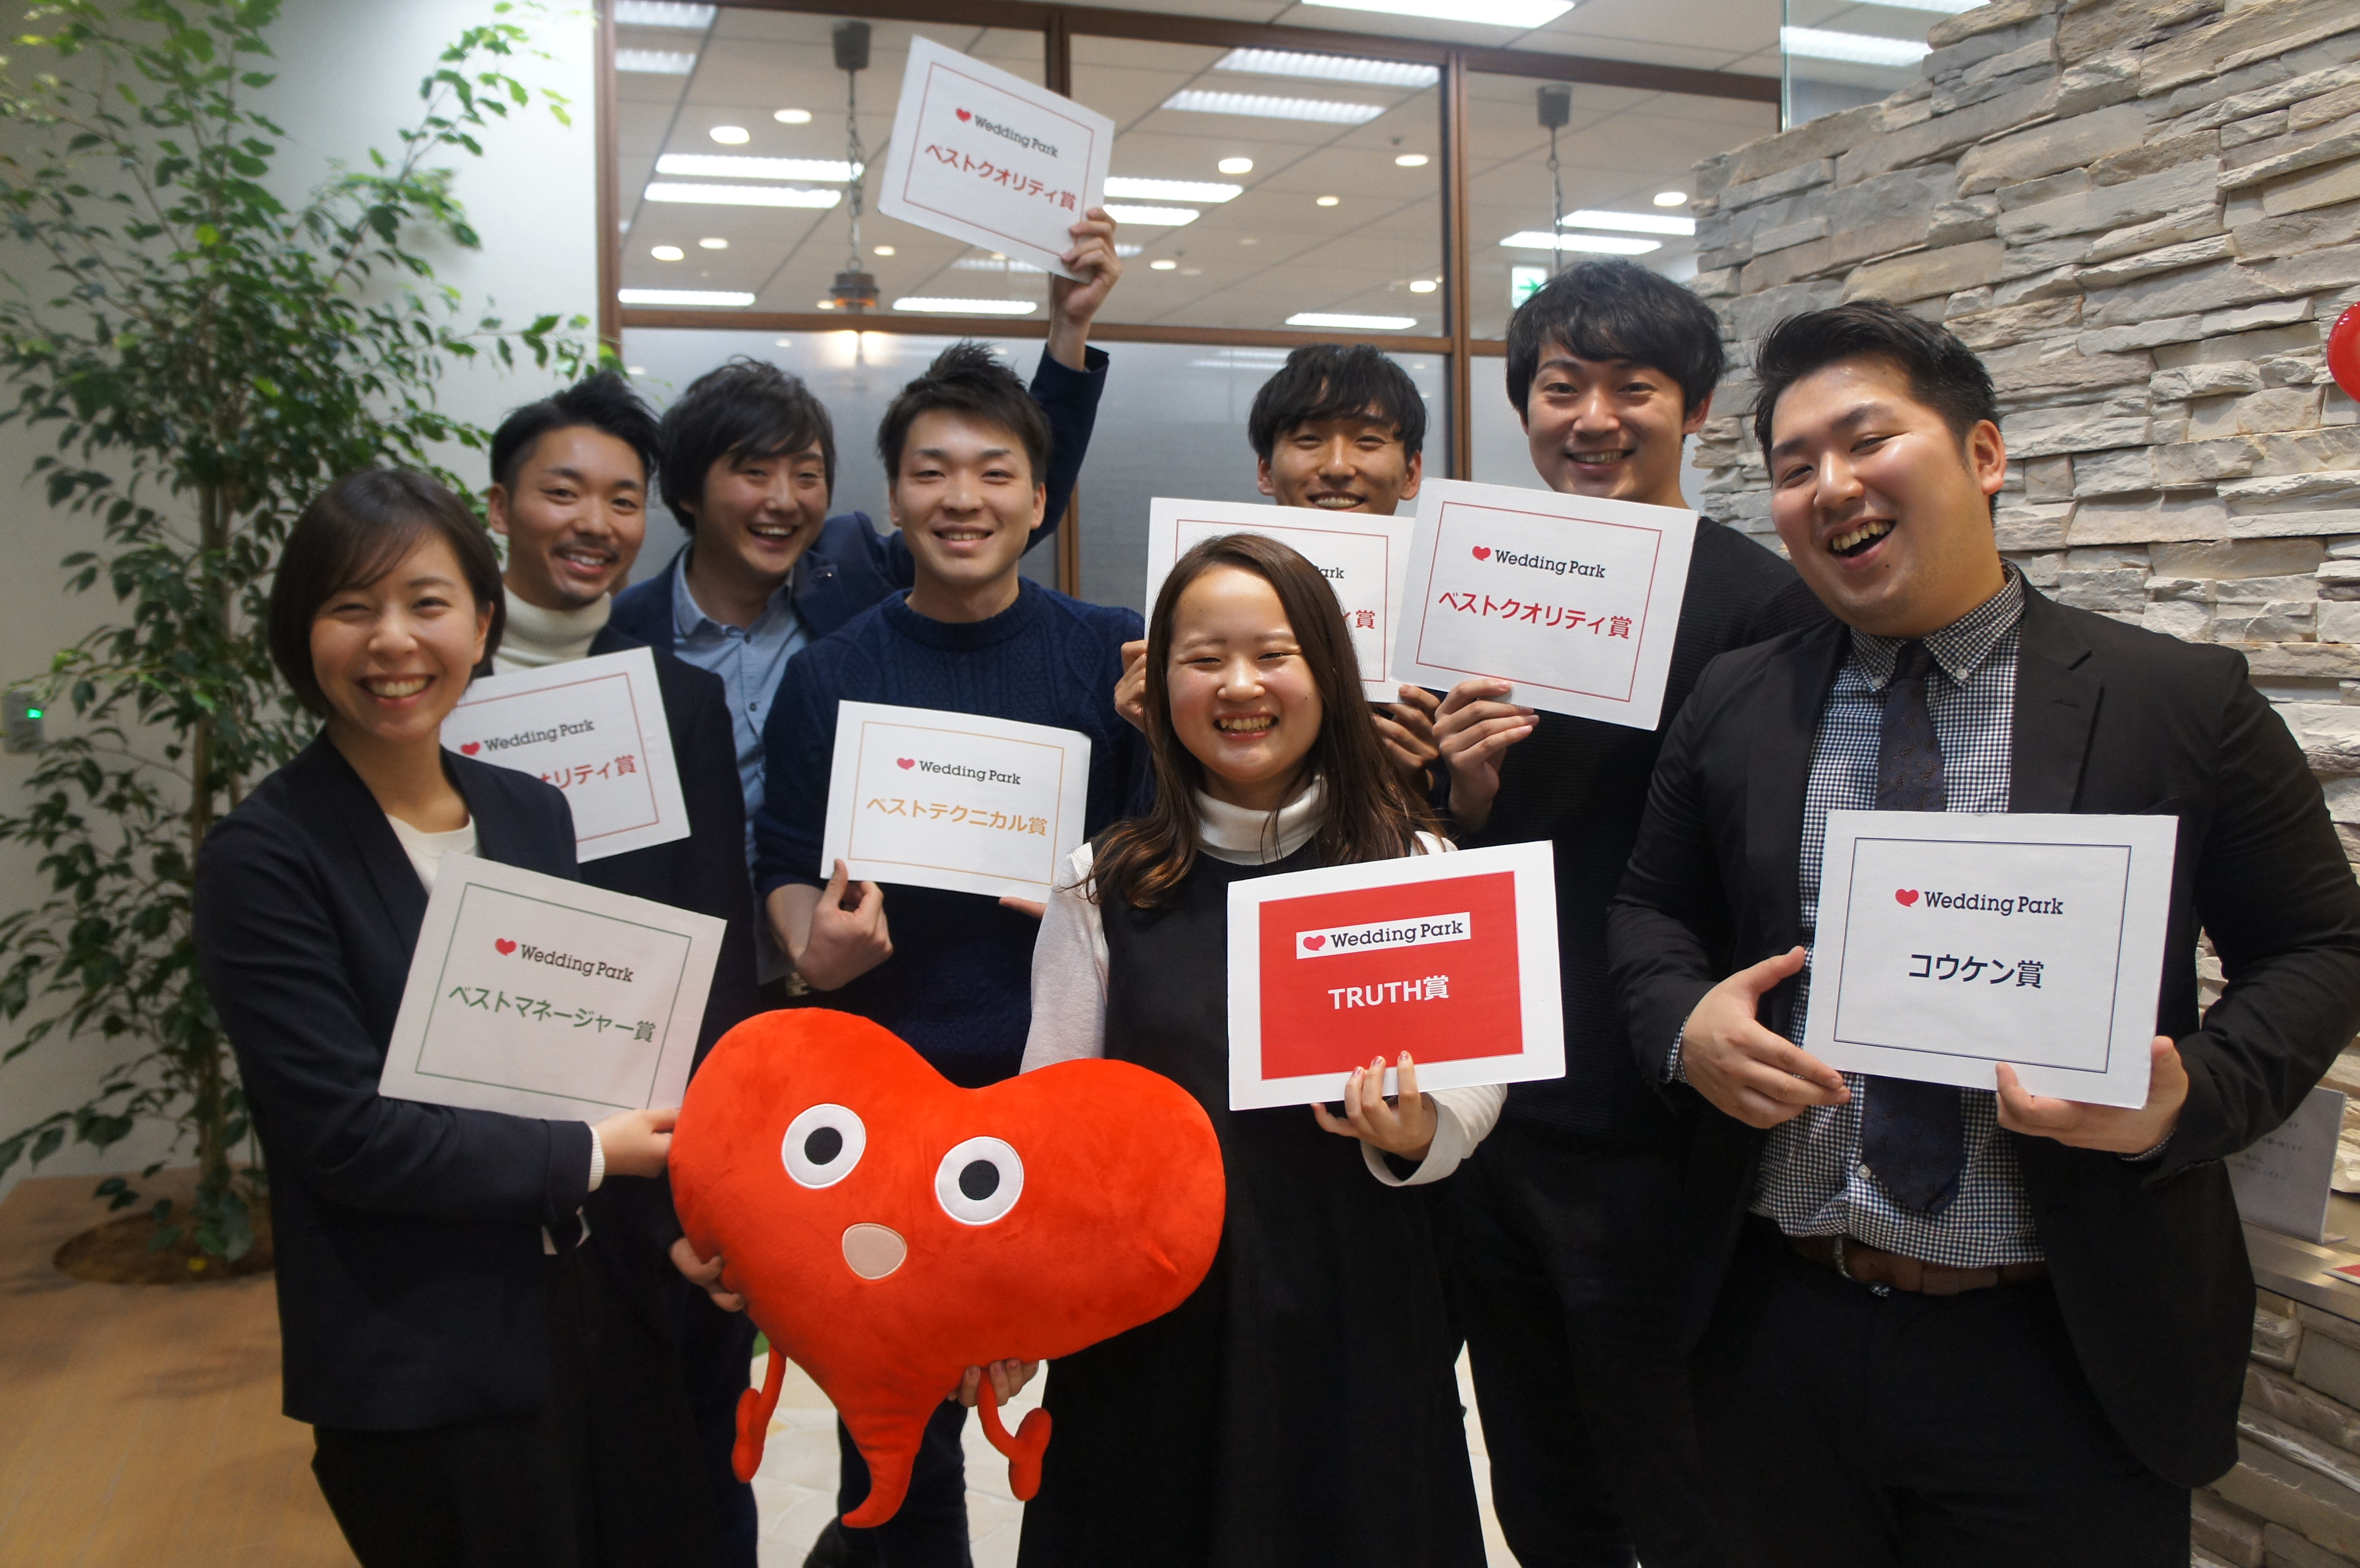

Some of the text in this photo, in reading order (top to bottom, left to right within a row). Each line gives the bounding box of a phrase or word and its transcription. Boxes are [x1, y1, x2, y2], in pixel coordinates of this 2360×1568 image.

[974, 115, 1058, 157] Wedding Park
[925, 144, 1077, 211] ベストクオリティ賞
[1314, 566, 1344, 579] ark
[1495, 549, 1606, 578] Wedding Park
[1438, 591, 1633, 640] ベストクオリティ賞
[484, 720, 595, 752] Wedding Park
[919, 760, 1021, 785] Wedding Park
[867, 797, 1048, 836] ベストテクニカル賞
[1924, 891, 2063, 916] Wedding Park
[1330, 920, 1463, 948] Wedding Park
[521, 944, 634, 982] Wedding Park
[1908, 954, 2044, 989] コウケン賞
[1328, 975, 1449, 1010] TRUTH賞
[449, 986, 656, 1043] ベストマネージャー賞
